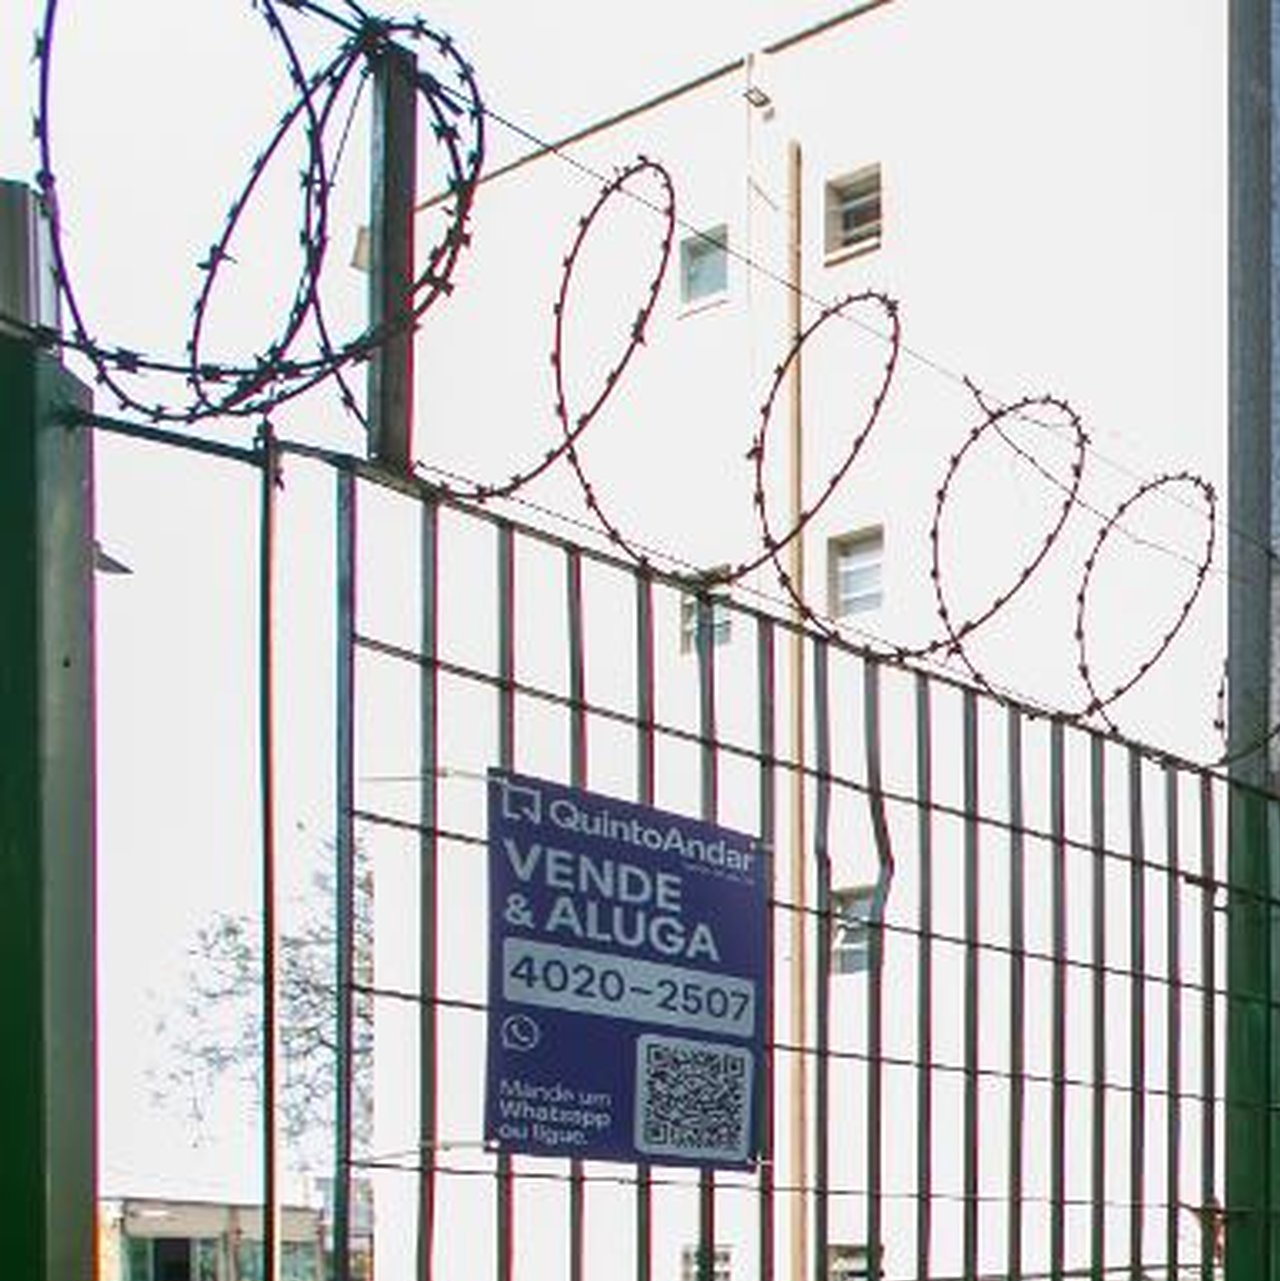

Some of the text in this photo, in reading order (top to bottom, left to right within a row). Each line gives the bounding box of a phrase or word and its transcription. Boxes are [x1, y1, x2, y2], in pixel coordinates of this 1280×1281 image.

[549, 798, 755, 872] QuintoAndar
[504, 839, 682, 911] VENDE
[505, 893, 720, 962] & ALUGA
[510, 955, 750, 1022] 4020-2507
[579, 1092, 612, 1107] um
